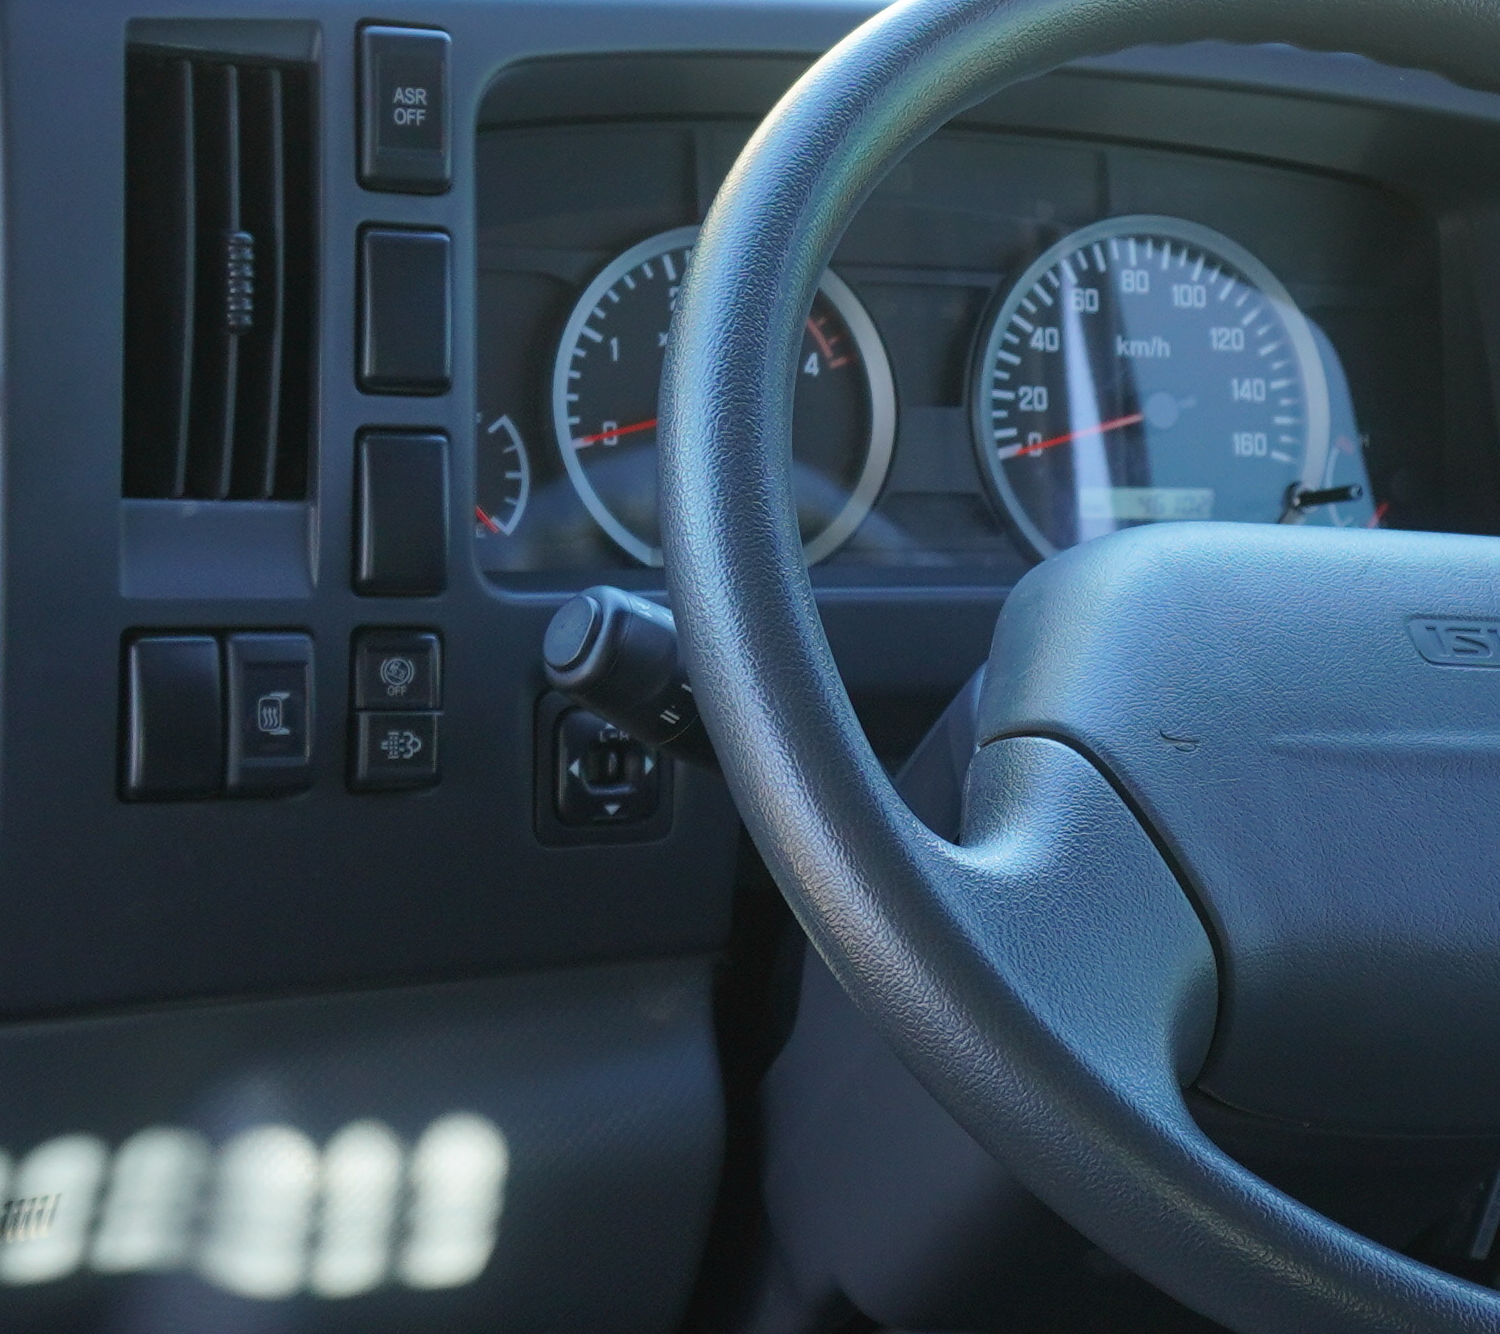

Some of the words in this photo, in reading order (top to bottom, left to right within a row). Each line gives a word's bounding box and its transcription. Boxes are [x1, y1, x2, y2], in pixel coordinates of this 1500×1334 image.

[393, 87, 428, 106] ASR
[393, 108, 427, 127] OFF
[1120, 269, 1149, 294] 80
[1071, 288, 1099, 313] 60
[1171, 283, 1207, 309] 100
[610, 336, 620, 363] 1
[1030, 327, 1059, 352] 40
[1115, 334, 1171, 359] km/h
[1210, 327, 1245, 351] 120
[803, 352, 820, 377] 4
[1018, 385, 1049, 412] 20
[1231, 379, 1267, 403] 140
[602, 420, 619, 447] 0
[1027, 432, 1043, 458] 0
[1232, 433, 1268, 457] 160
[386, 685, 408, 697] OFF
